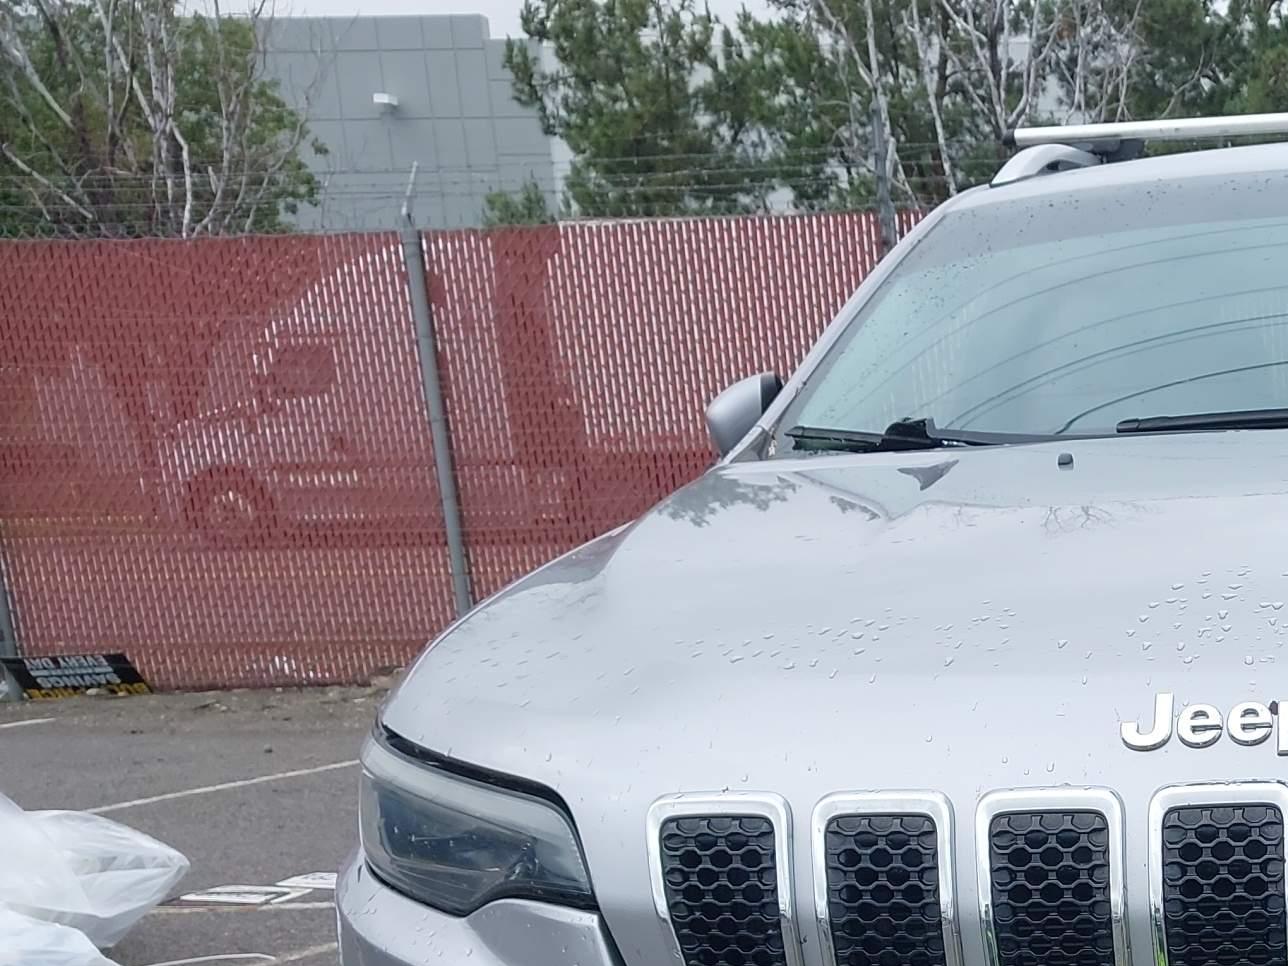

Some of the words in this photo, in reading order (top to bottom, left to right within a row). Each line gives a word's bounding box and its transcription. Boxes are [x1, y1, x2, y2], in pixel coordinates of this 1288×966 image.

[23, 657, 56, 671] DAY
[58, 655, 109, 668] EVERY
[36, 672, 121, 689] SAVINGS
